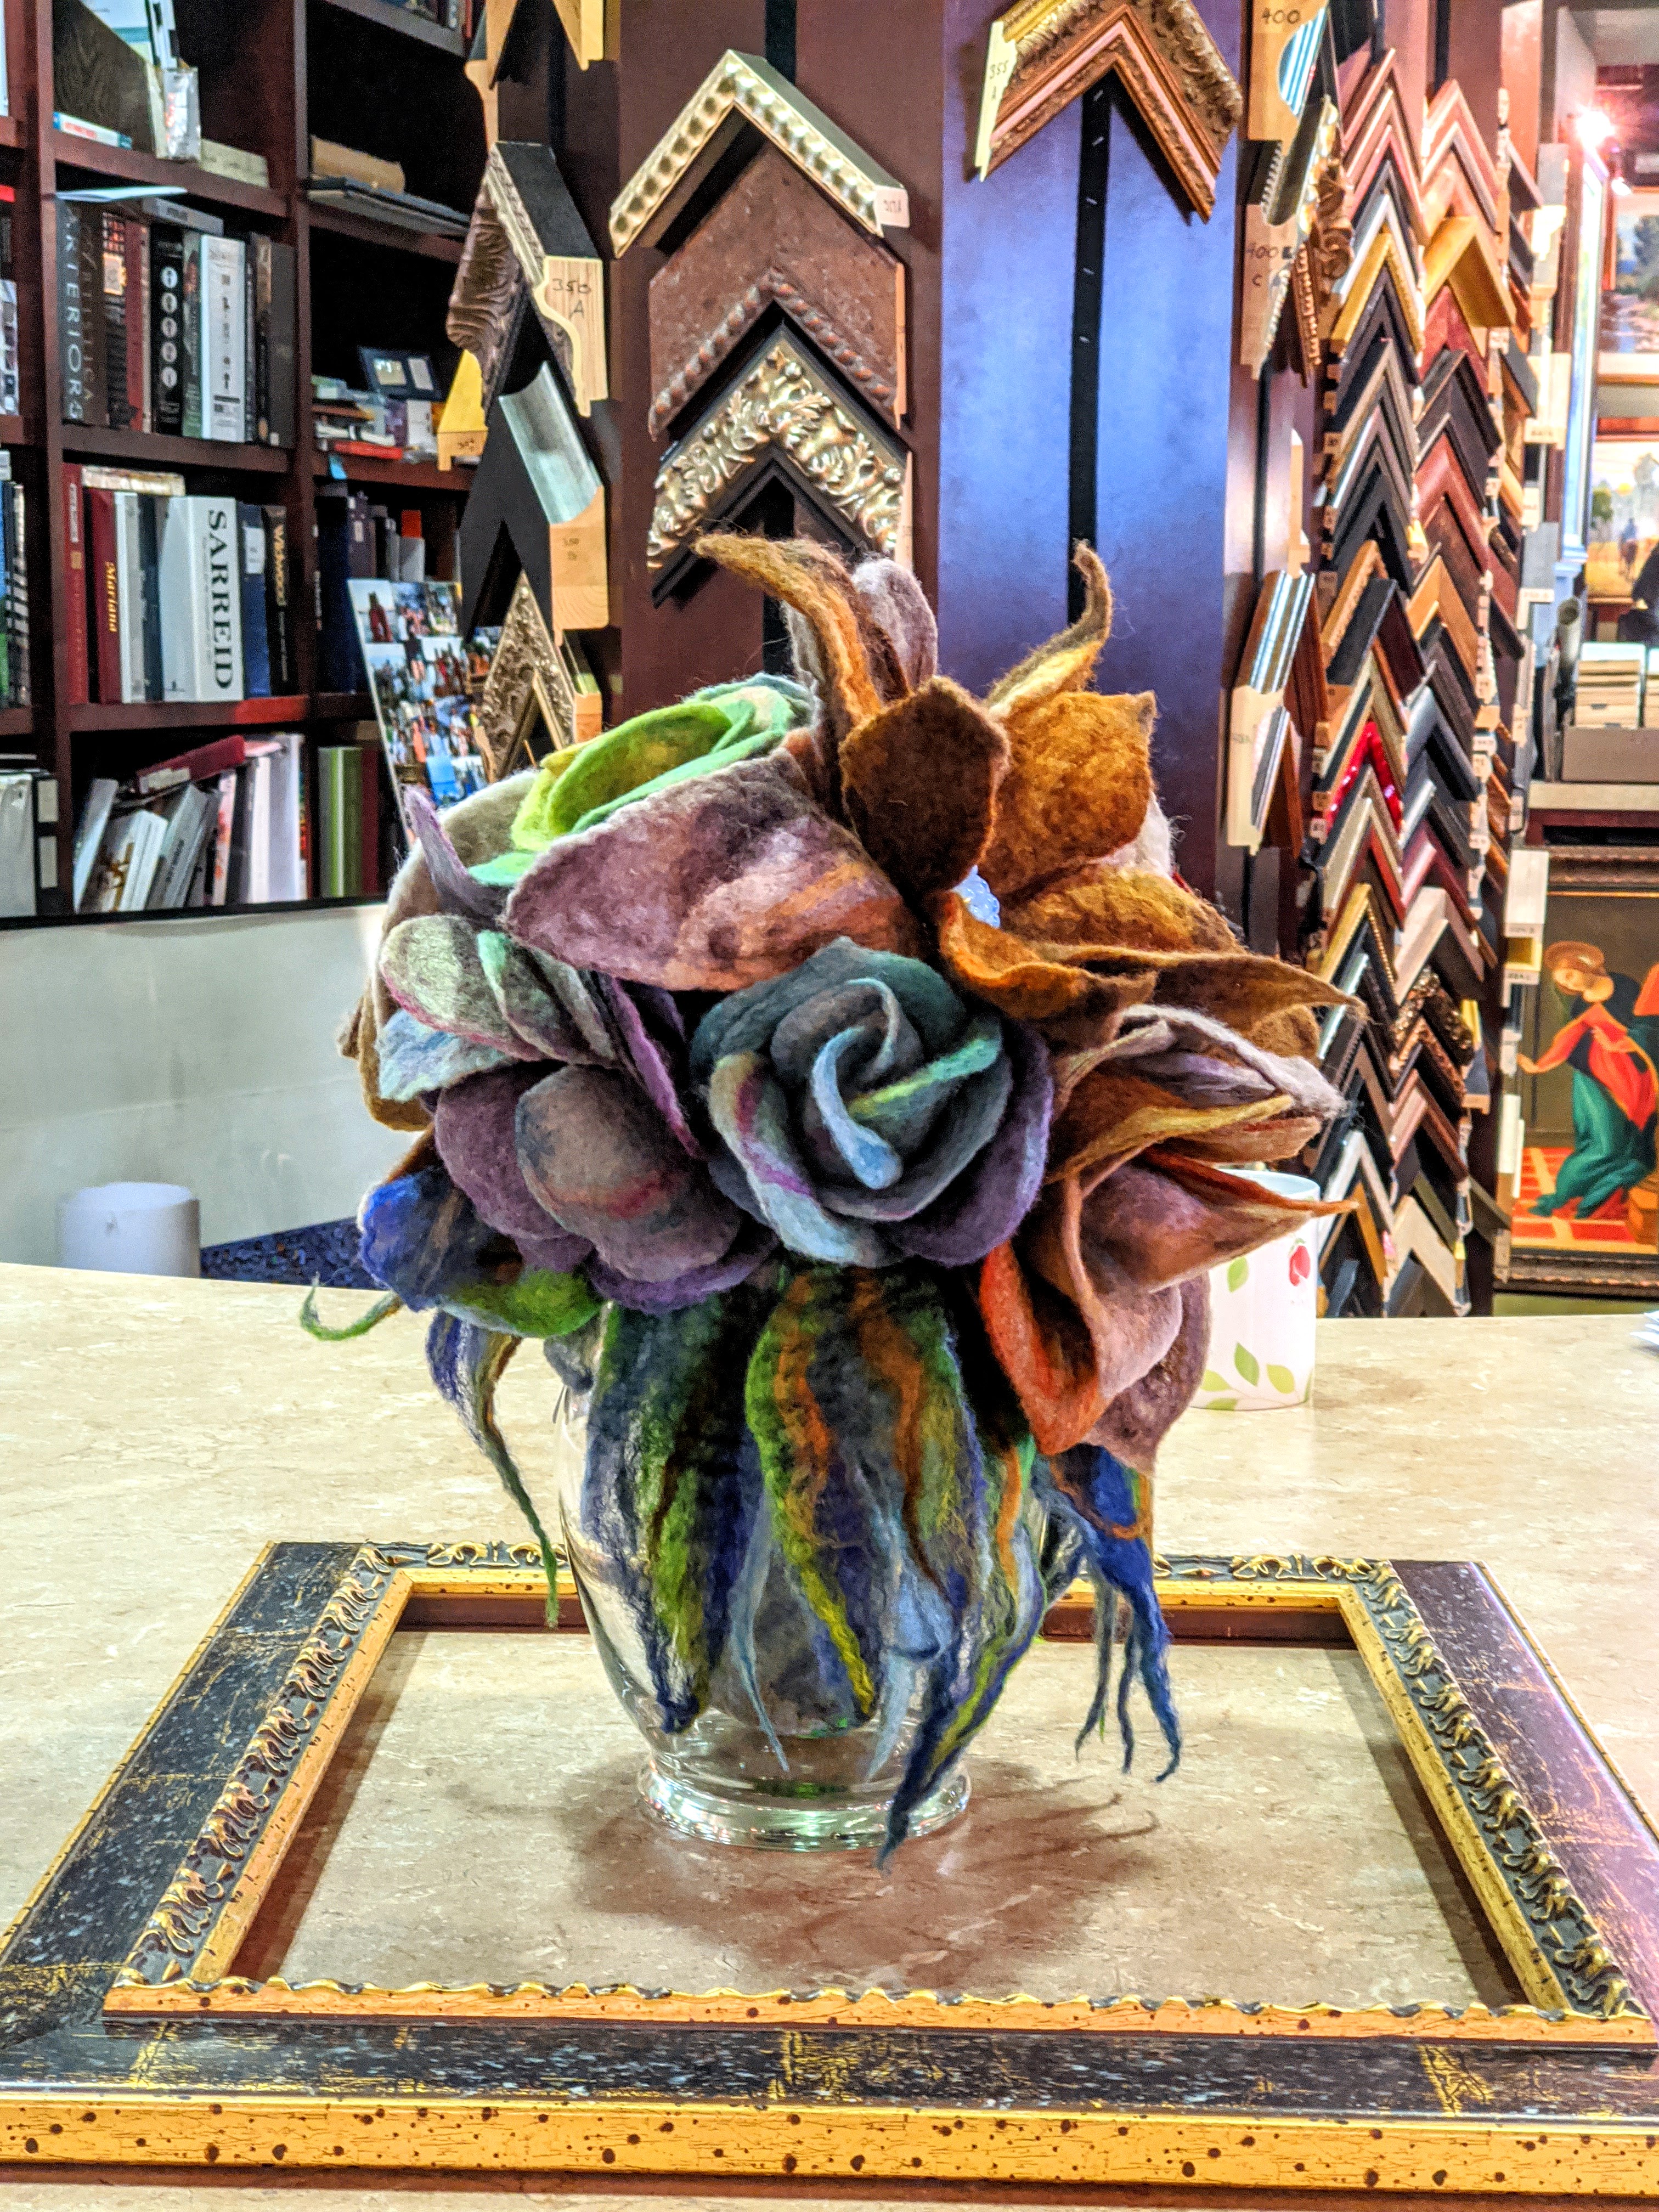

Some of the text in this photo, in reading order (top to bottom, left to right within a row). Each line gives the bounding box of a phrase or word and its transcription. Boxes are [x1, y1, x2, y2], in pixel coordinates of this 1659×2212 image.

[569, 300, 584, 318] A
[105, 562, 117, 633] Mariana
[208, 510, 233, 689] SARREID
